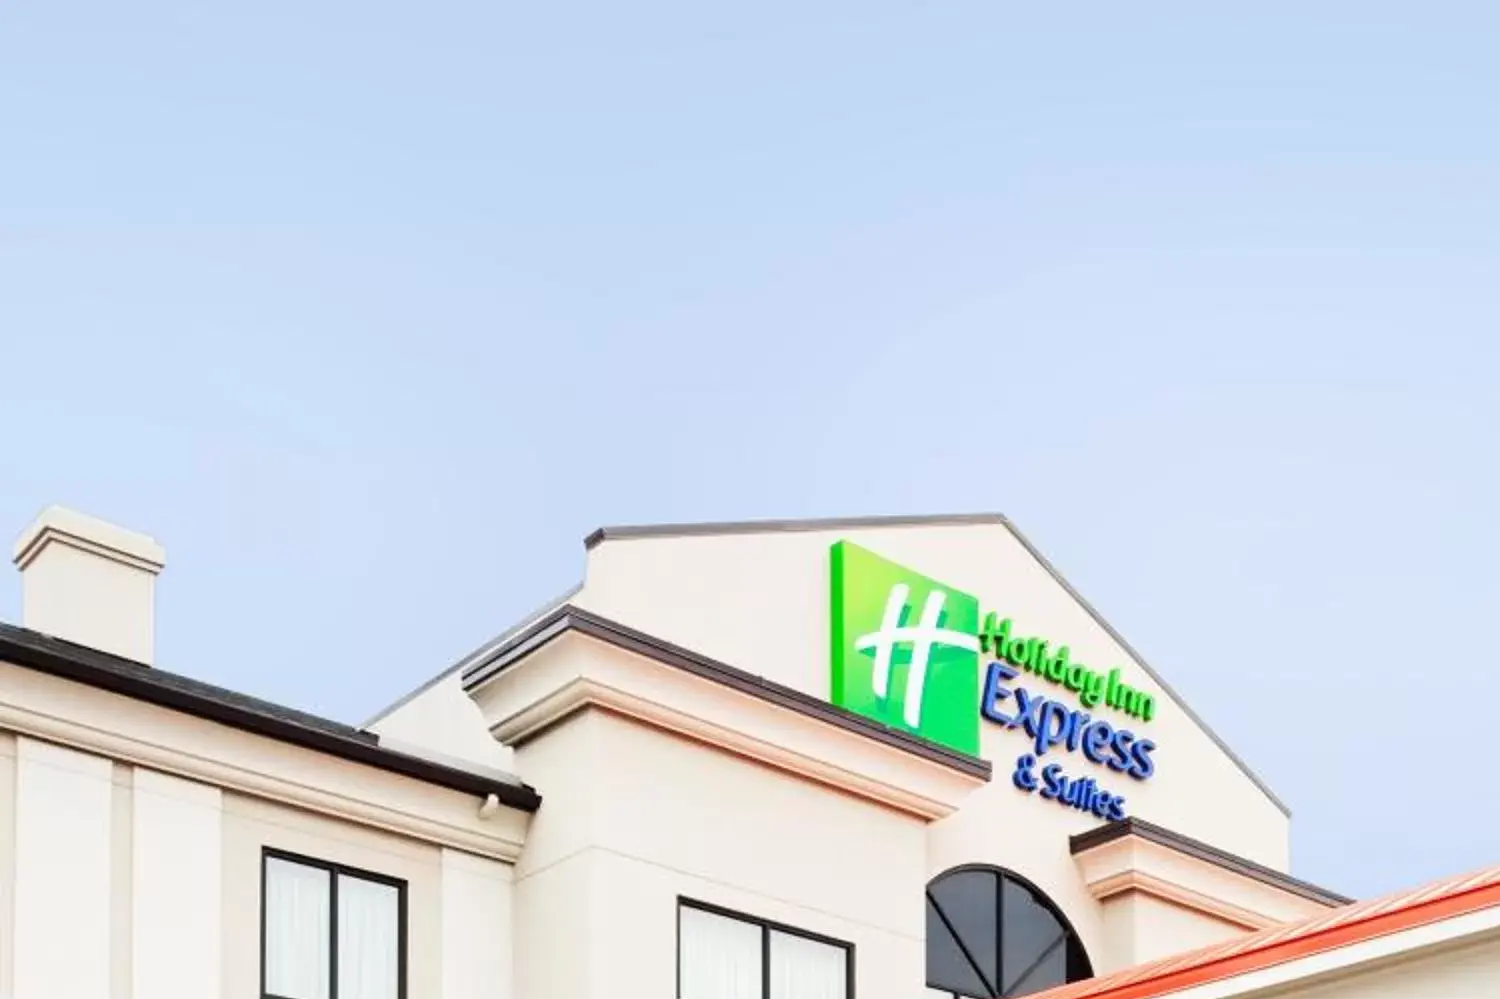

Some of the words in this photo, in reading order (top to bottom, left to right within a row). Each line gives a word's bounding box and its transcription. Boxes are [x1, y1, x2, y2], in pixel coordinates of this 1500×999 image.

[979, 612, 1105, 709] Holiday
[1104, 668, 1155, 722] Inn
[980, 661, 1156, 780] Express
[1012, 753, 1038, 791] &
[1040, 763, 1125, 822] Suites
